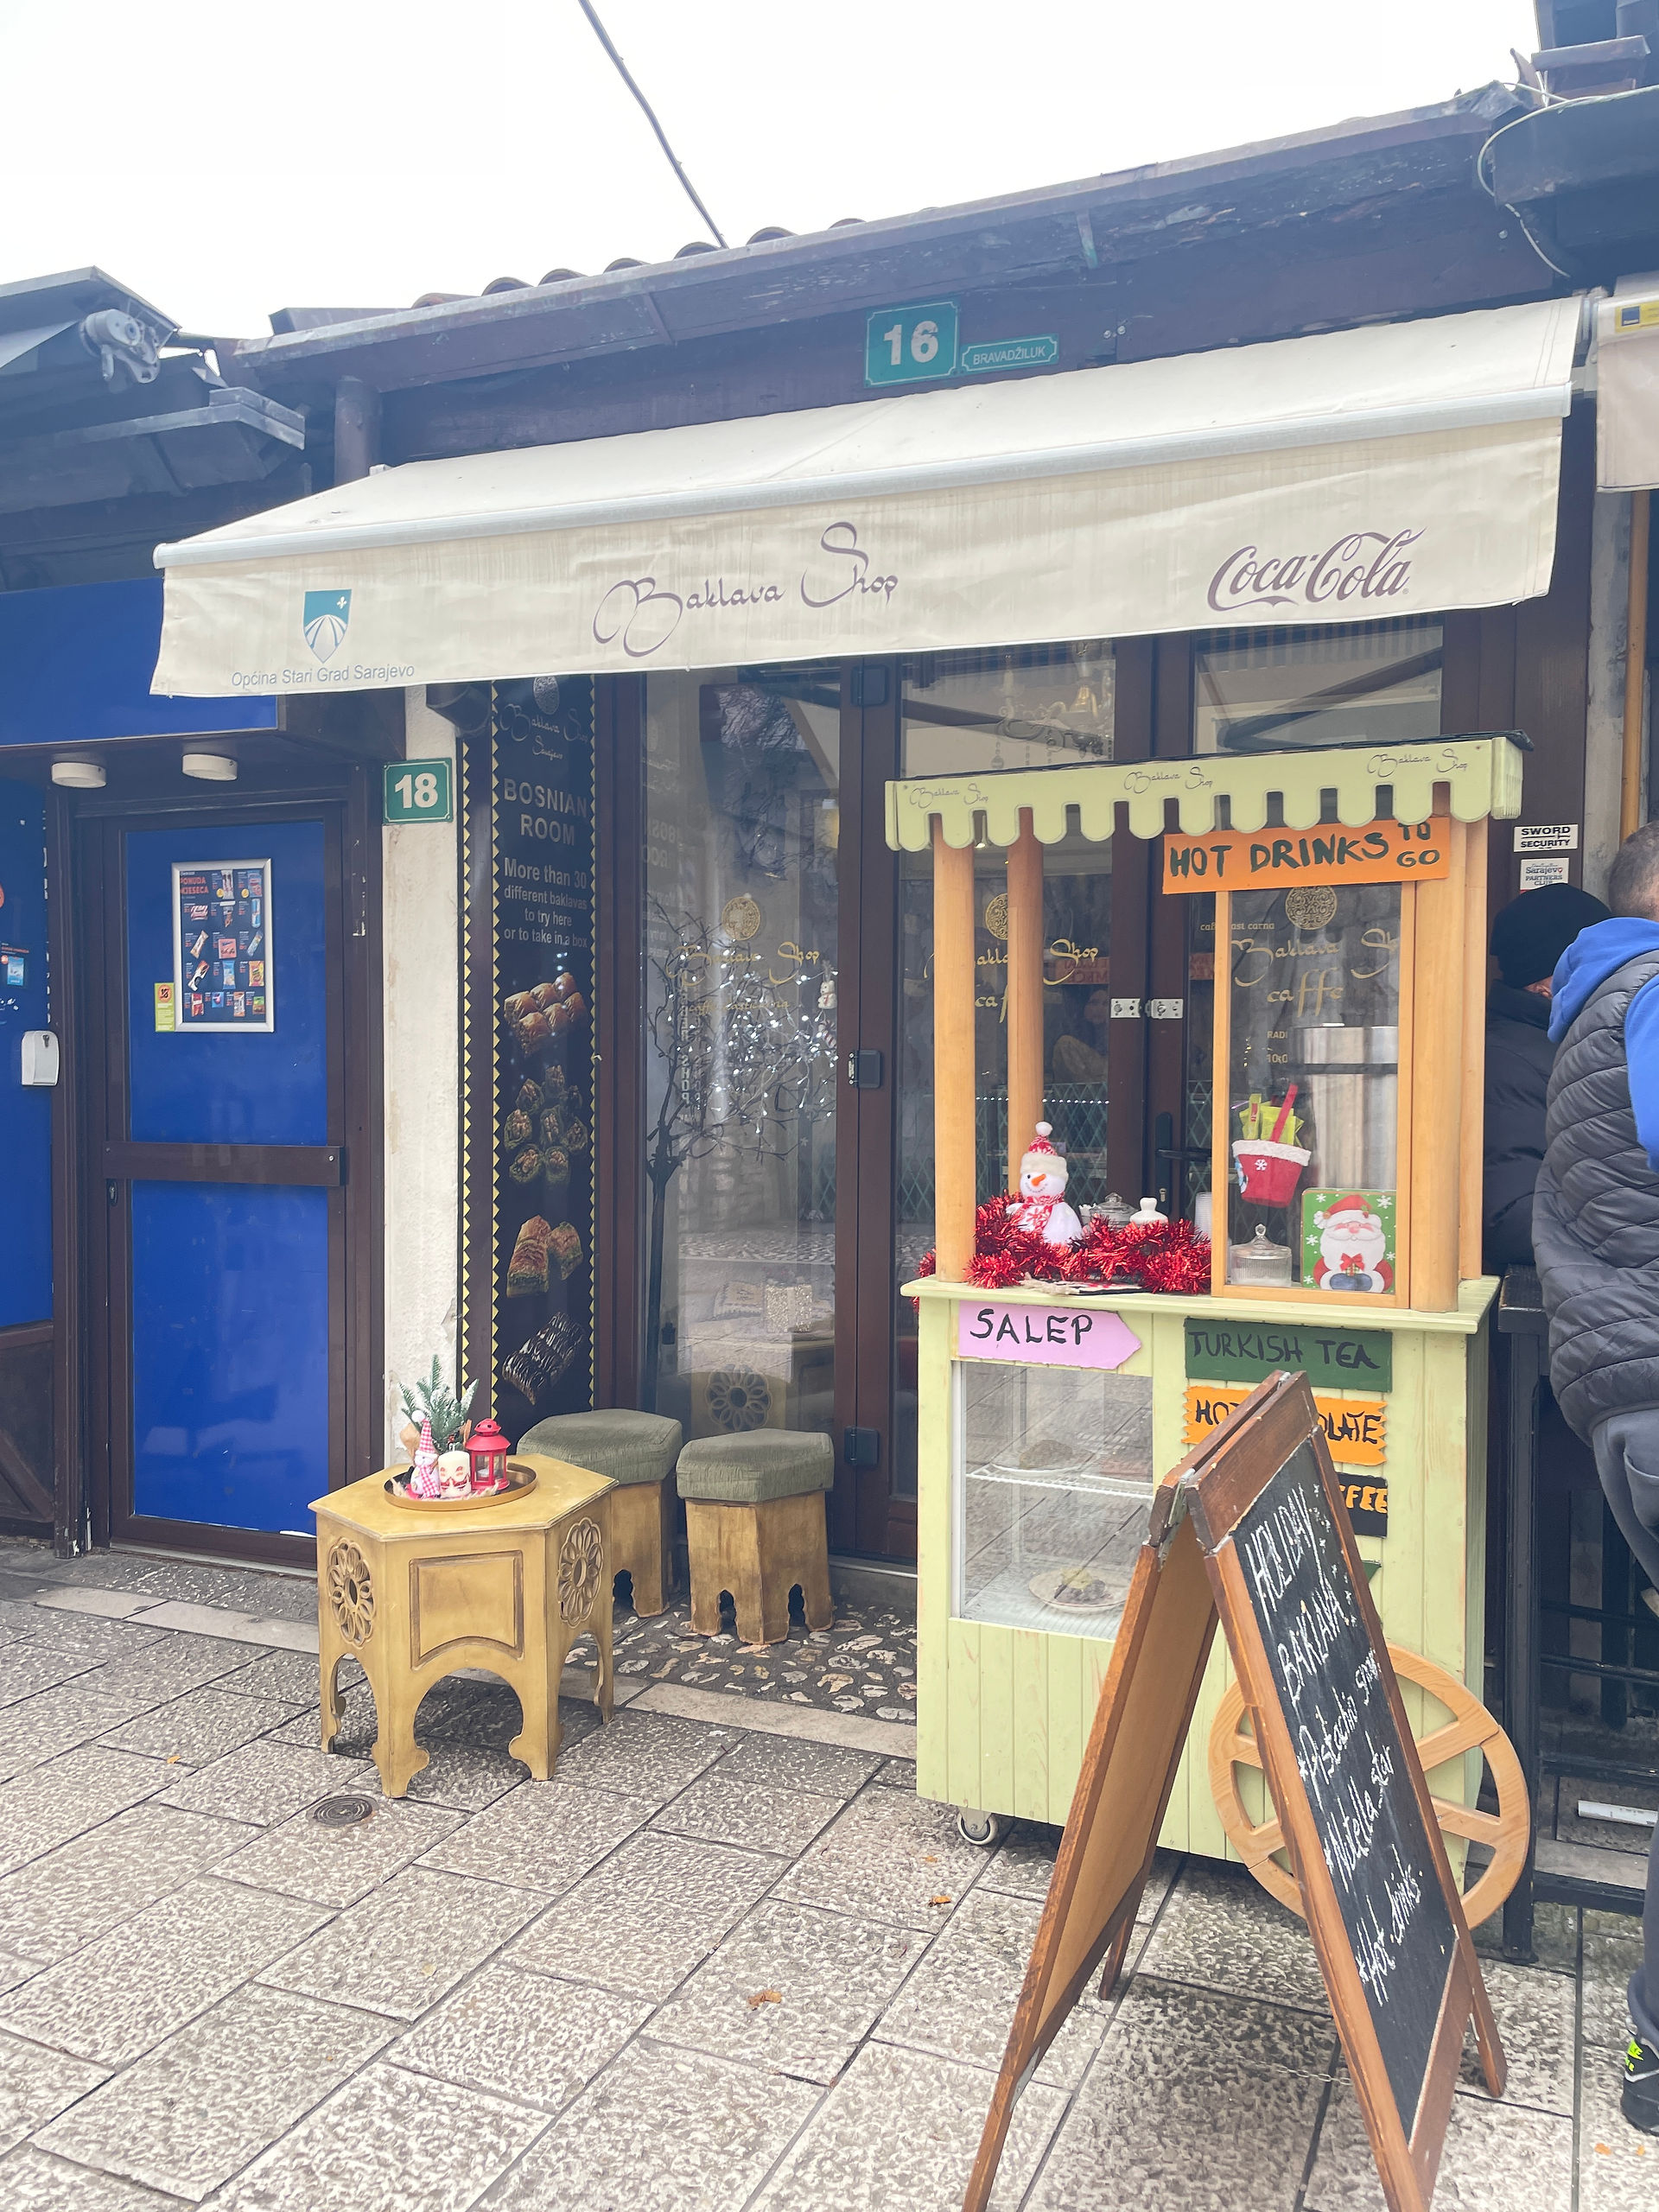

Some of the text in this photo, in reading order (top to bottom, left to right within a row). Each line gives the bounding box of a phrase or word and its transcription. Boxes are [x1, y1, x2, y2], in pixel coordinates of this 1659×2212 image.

[883, 321, 939, 365] 16
[973, 346, 1046, 365] BRAVADŽILUK
[1207, 525, 1427, 612] Coca-Cola
[593, 521, 899, 658] Baklava Shop
[232, 664, 415, 690] Općina Stari Grad Sarajevo
[1124, 766, 1213, 794] Baklava Shop
[1367, 748, 1469, 778] Baklava Shop
[394, 772, 438, 810] 18
[504, 778, 588, 818] BOSNIAN
[963, 783, 988, 805] Shop
[520, 813, 575, 846] ROOM
[1521, 826, 1571, 836] SWORD
[1521, 839, 1570, 849] SECURITY
[1170, 845, 1232, 878] HOT
[1250, 831, 1389, 874] DRINKS
[1396, 849, 1440, 868] GO
[504, 857, 588, 890] More than 30
[504, 885, 588, 910] different baklavas
[524, 908, 572, 927] to try here
[504, 927, 516, 940] or
[518, 926, 529, 941] to
[531, 929, 552, 944] take
[573, 933, 588, 949] box
[768, 941, 820, 985] Shop
[1043, 938, 1099, 985] Shop
[969, 1308, 1093, 1345] SALEP
[1187, 1331, 1381, 1370] TURKISH TEA
[1339, 1484, 1388, 1514] FEE
[1244, 1482, 1324, 1626] HOLIDAY
[1276, 1578, 1348, 1705] BAKLAVA
[1325, 1730, 1395, 1893] Nutella star
[1357, 1843, 1421, 2007] Hot drinks
